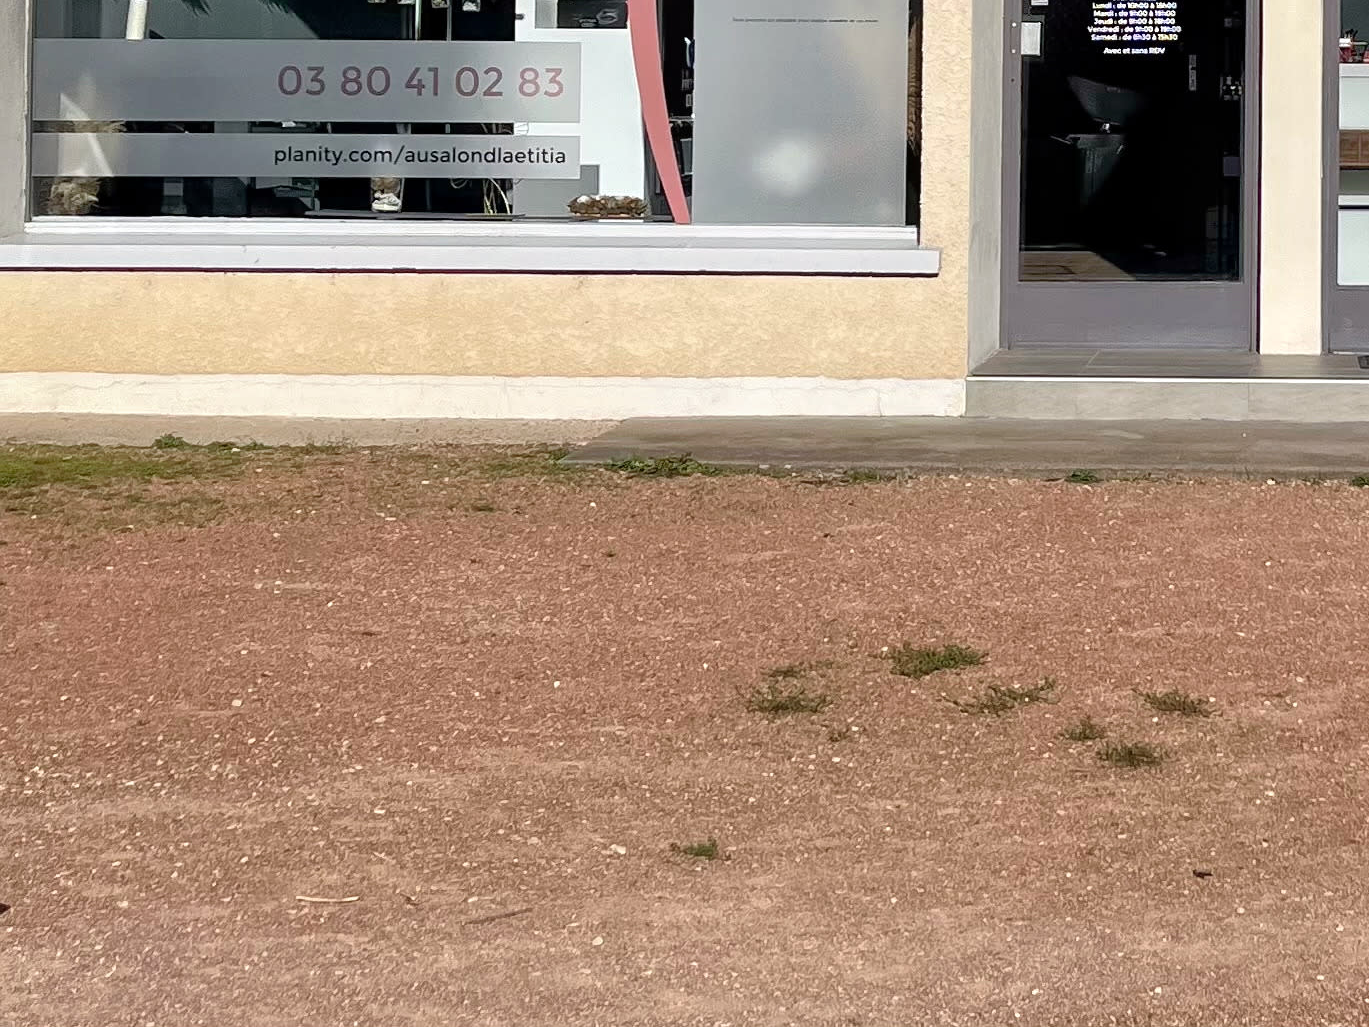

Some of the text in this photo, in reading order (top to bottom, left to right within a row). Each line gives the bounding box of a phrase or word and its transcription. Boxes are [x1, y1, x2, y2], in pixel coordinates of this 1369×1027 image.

[1091, 33, 1117, 41] Samedi
[277, 65, 565, 98] 03 80 41 02 83
[273, 145, 567, 167] planity.com/ausalondlaetitia
